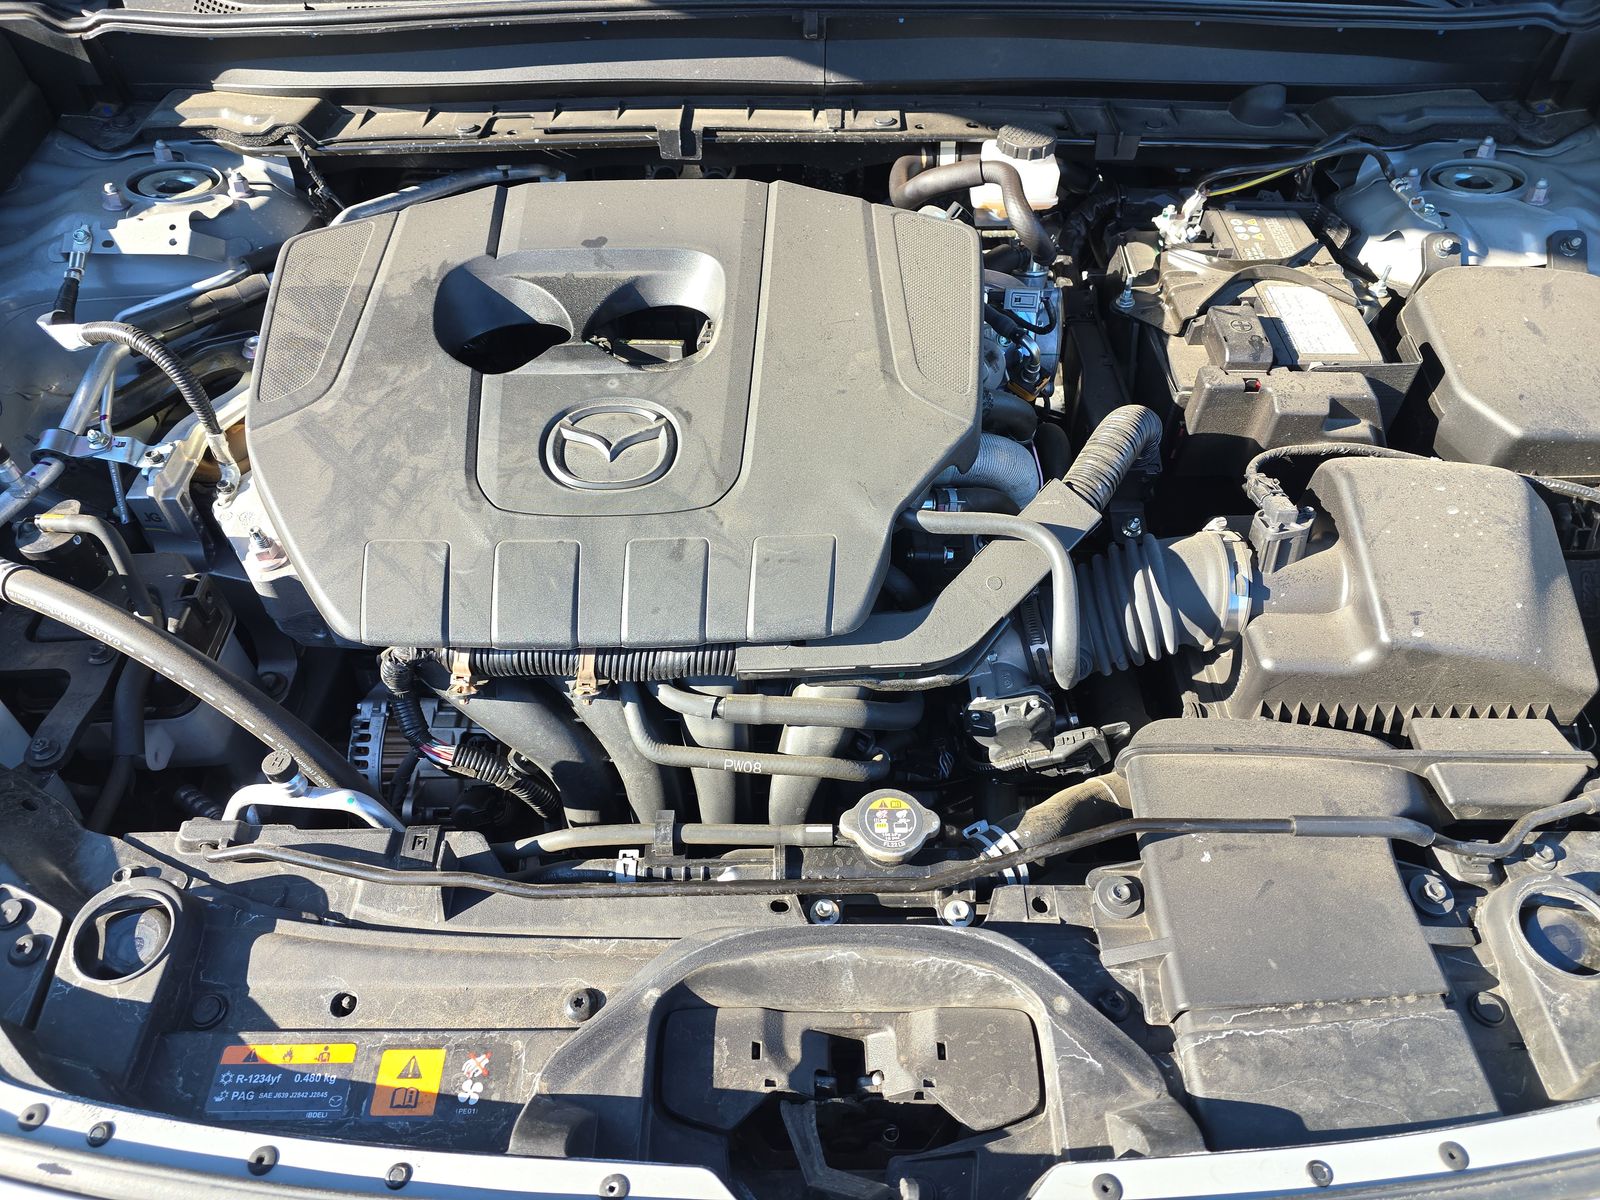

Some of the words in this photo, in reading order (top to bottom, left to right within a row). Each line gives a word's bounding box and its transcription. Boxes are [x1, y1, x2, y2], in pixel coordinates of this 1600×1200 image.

[83, 622, 122, 646] GALAXY
[723, 758, 762, 773] PW08
[235, 1074, 282, 1085] R-1234yf
[294, 1073, 321, 1083] 0.480
[323, 1073, 337, 1085] kg
[231, 1091, 255, 1101] PAG
